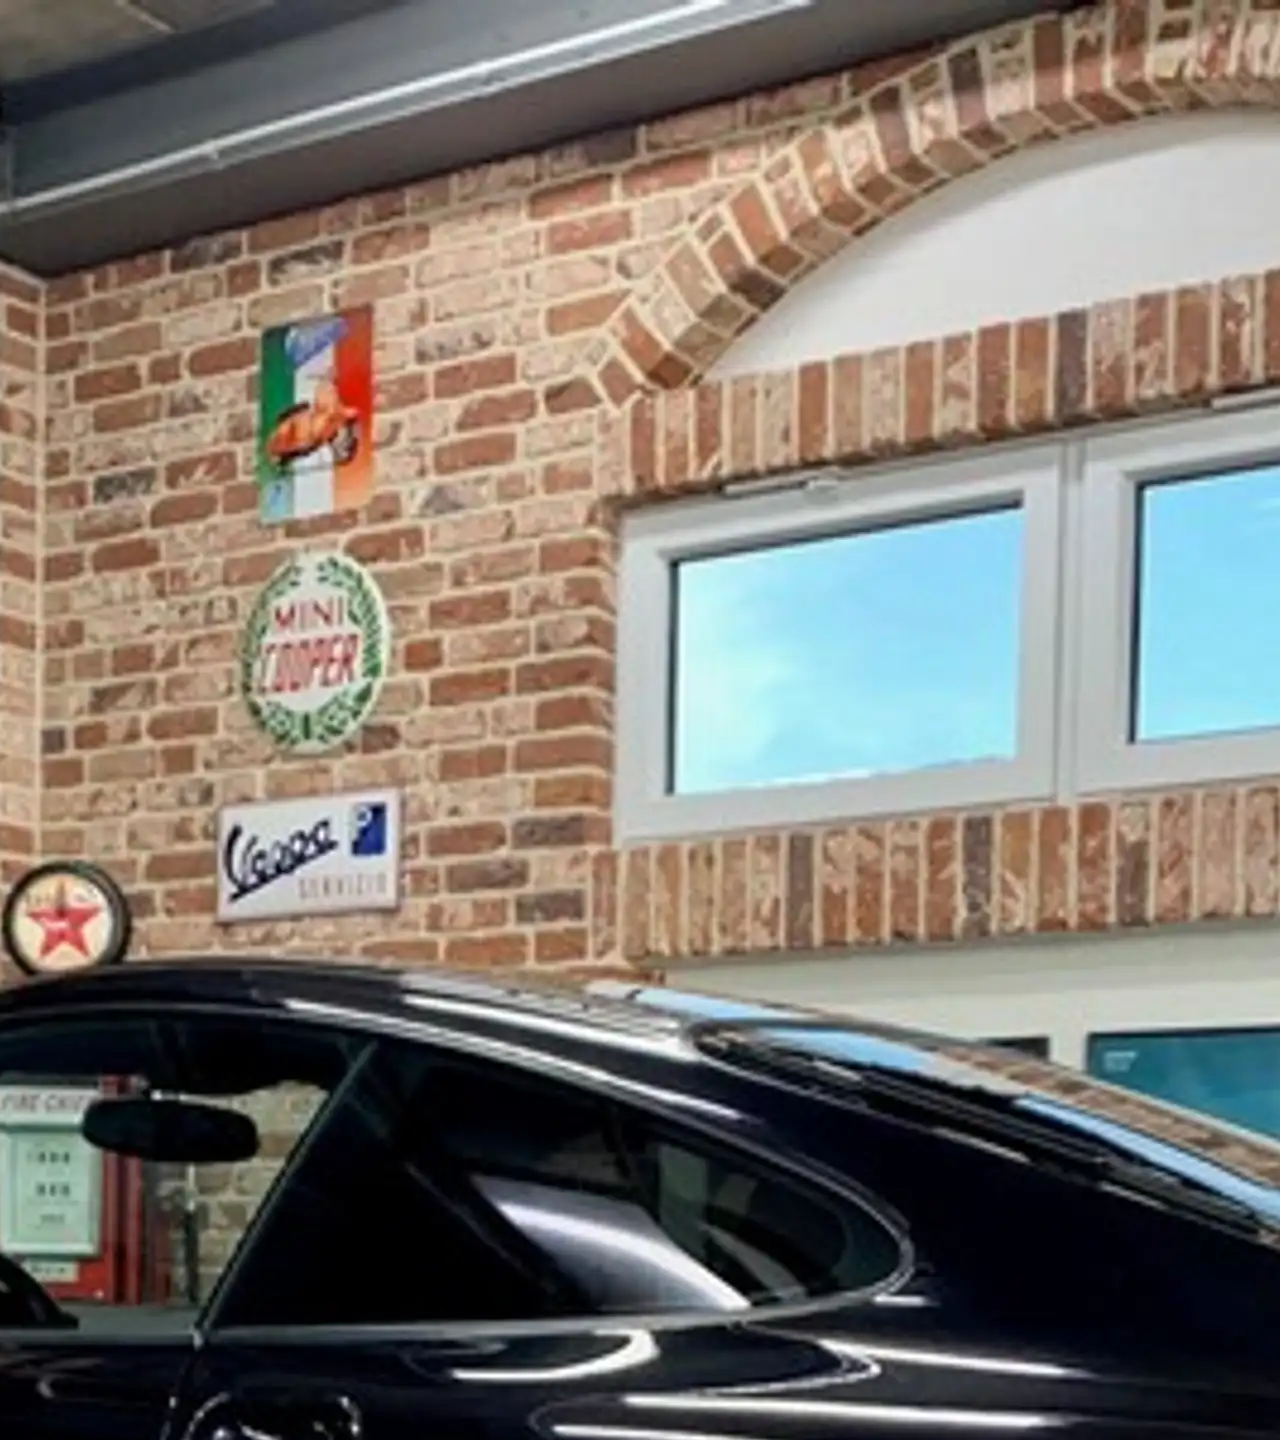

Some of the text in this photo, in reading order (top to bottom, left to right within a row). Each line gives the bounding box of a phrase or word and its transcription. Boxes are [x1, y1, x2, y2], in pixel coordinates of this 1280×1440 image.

[274, 596, 346, 629] MINI
[259, 632, 360, 695] COOPER
[224, 820, 339, 903] Vespa
